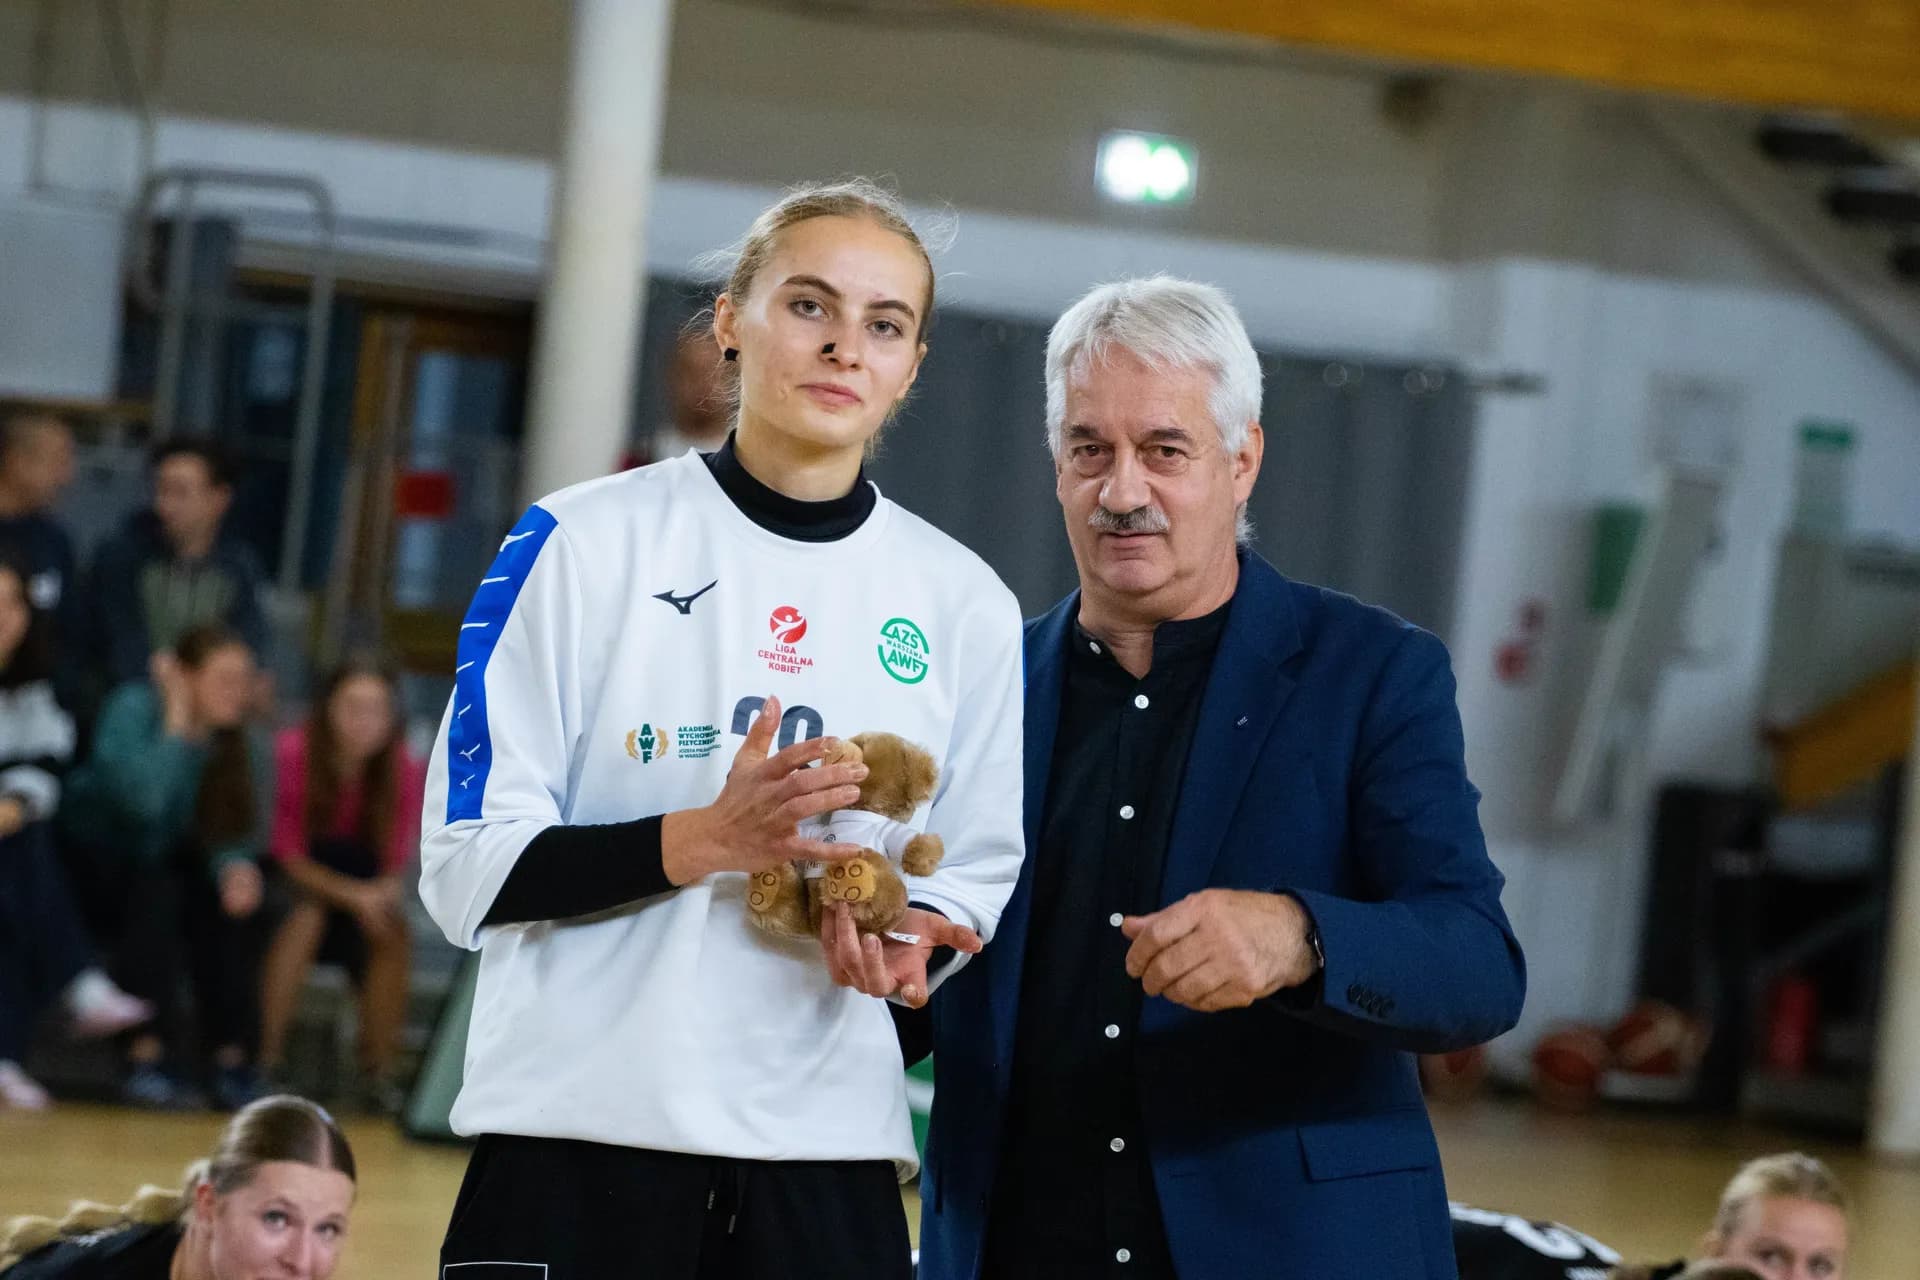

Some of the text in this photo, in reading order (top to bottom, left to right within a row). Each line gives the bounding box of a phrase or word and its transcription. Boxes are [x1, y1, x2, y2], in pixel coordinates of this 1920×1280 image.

[892, 626, 918, 649] AZS
[775, 643, 797, 654] LIGA
[886, 639, 922, 659] WARSZAWA
[758, 649, 813, 666] CENTRALNA
[887, 649, 920, 672] AWF
[768, 661, 802, 674] KOBIET
[677, 729, 721, 739] WYCHOWA
[678, 737, 716, 746] FIZYCZNE
[638, 723, 655, 764] AWF
